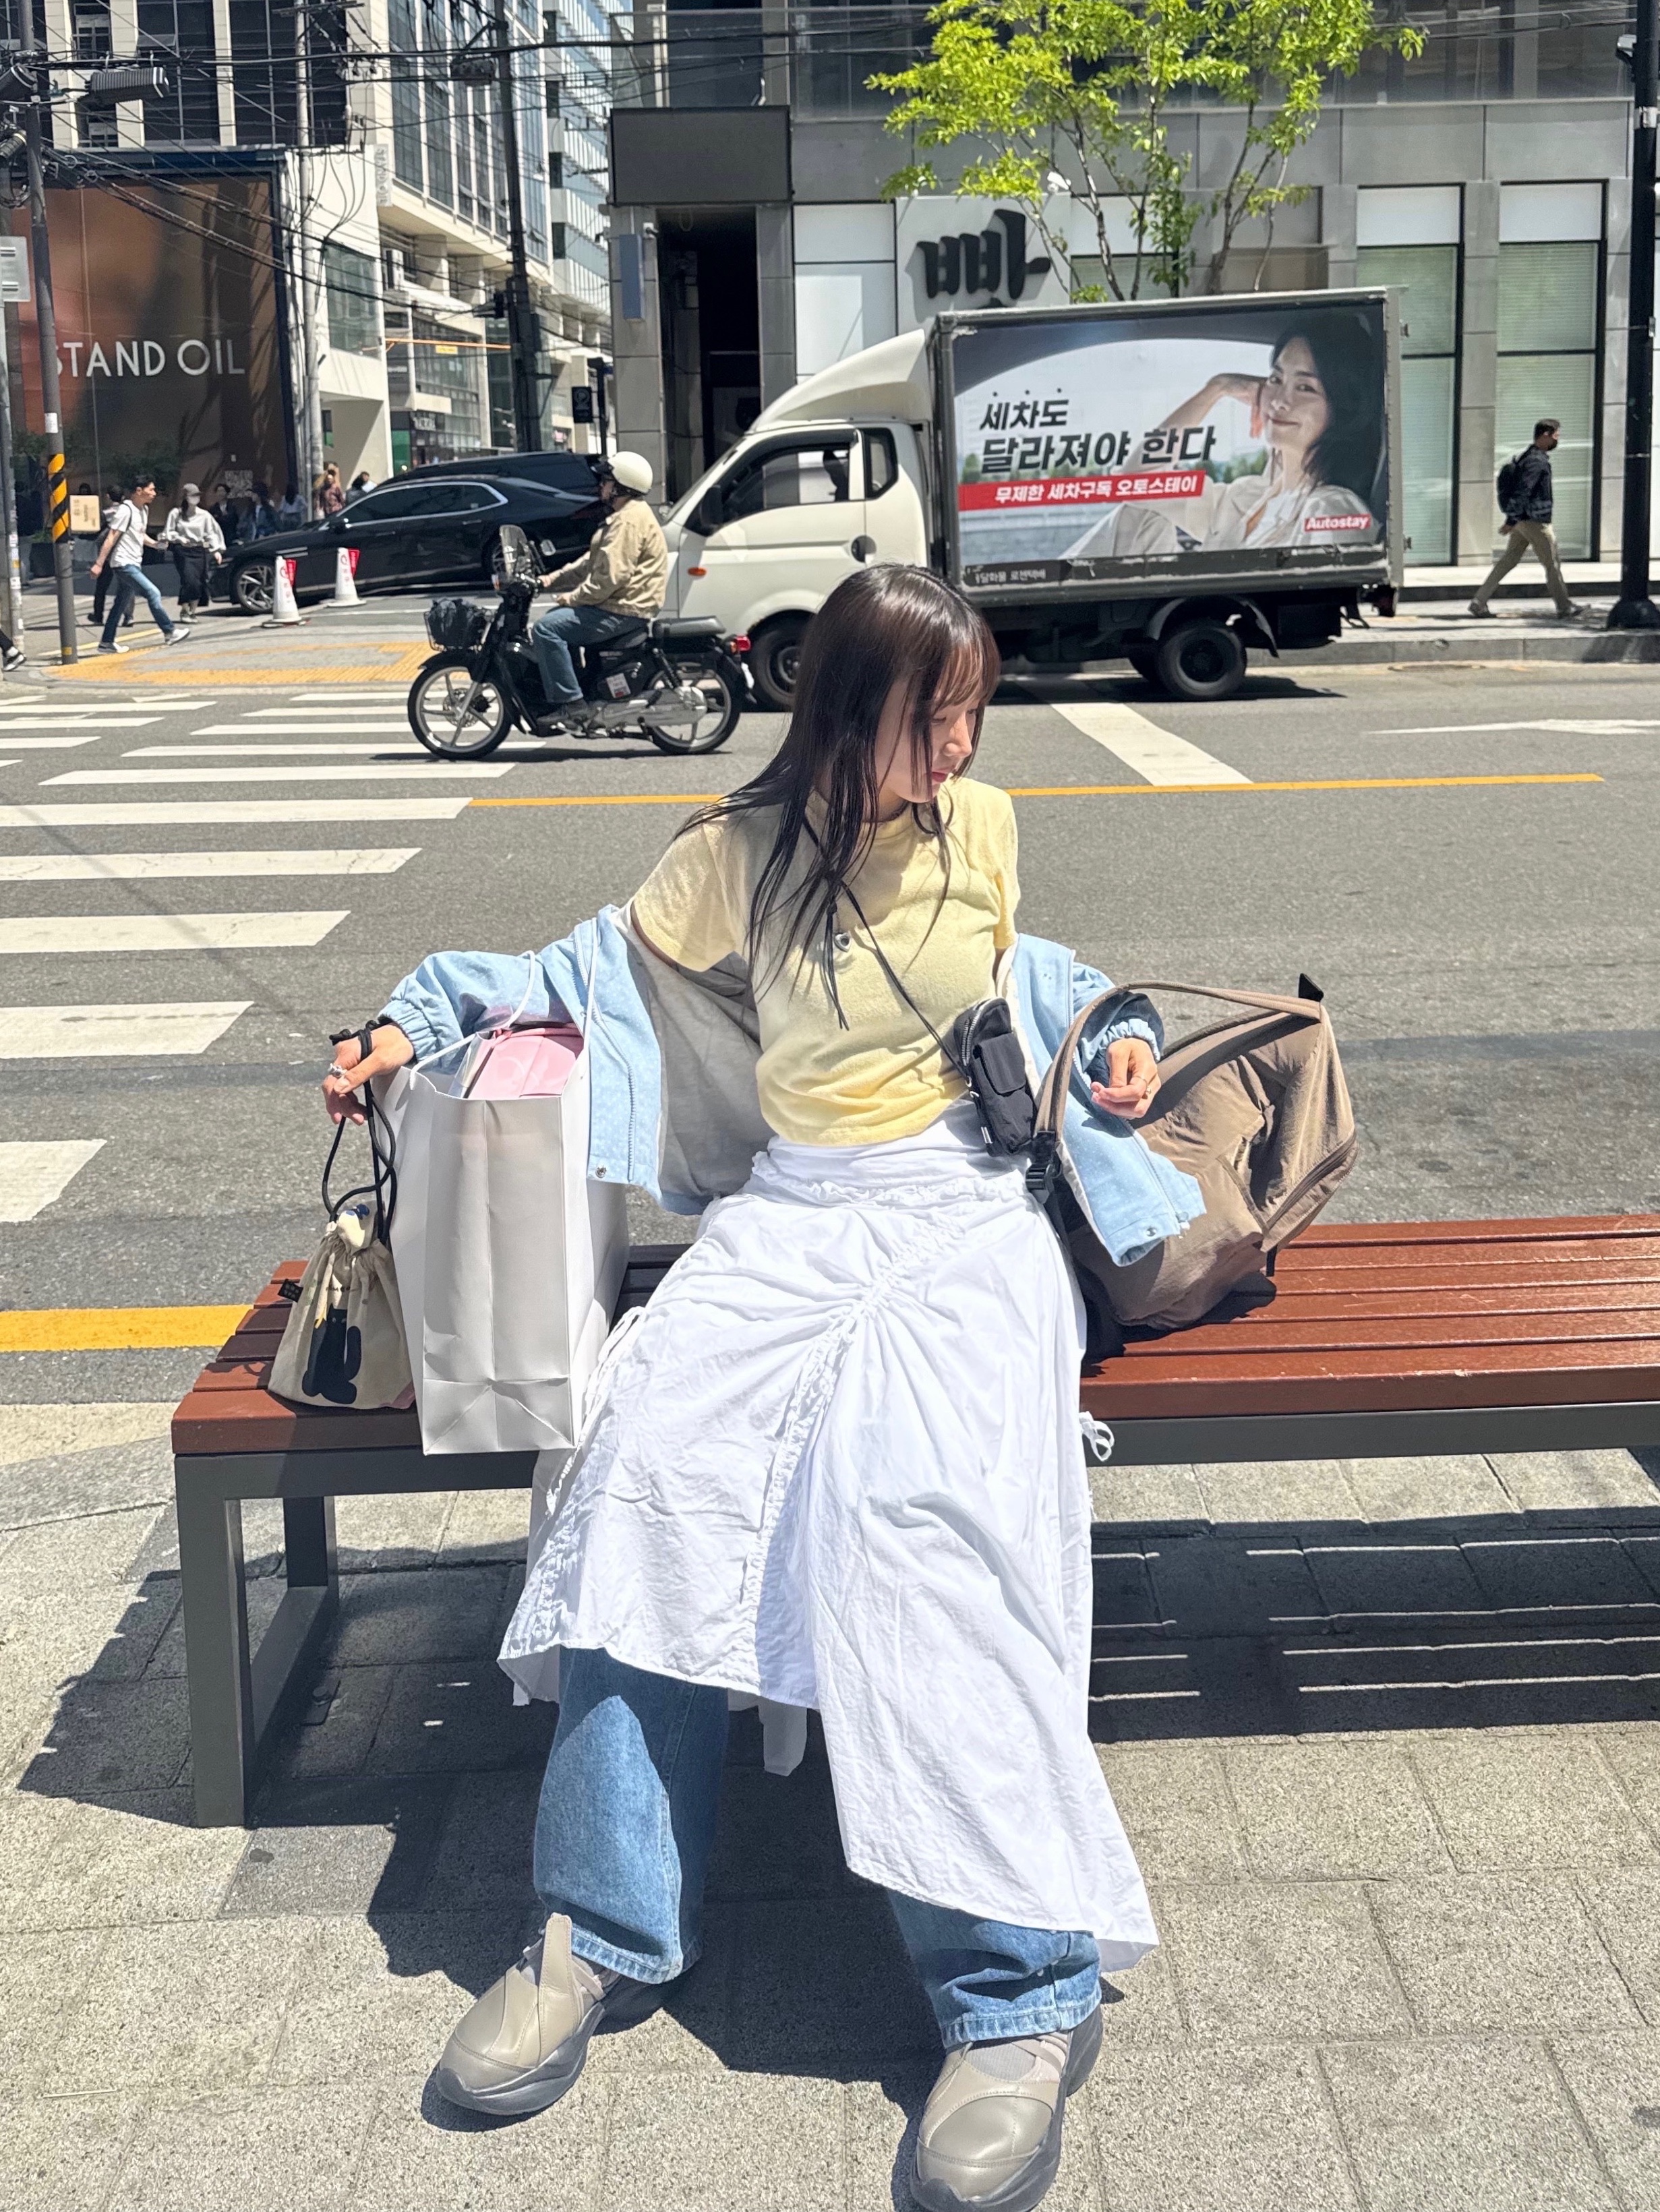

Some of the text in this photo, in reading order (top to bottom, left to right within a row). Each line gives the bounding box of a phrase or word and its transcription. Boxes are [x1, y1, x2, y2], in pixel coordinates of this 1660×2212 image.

[177, 339, 245, 376] OIL
[979, 399, 1069, 430] 세차도
[981, 425, 1216, 473] 달라져야 한다
[995, 475, 1197, 504] 무제한 세차구독 오토스테이
[1307, 516, 1369, 529] Autostay
